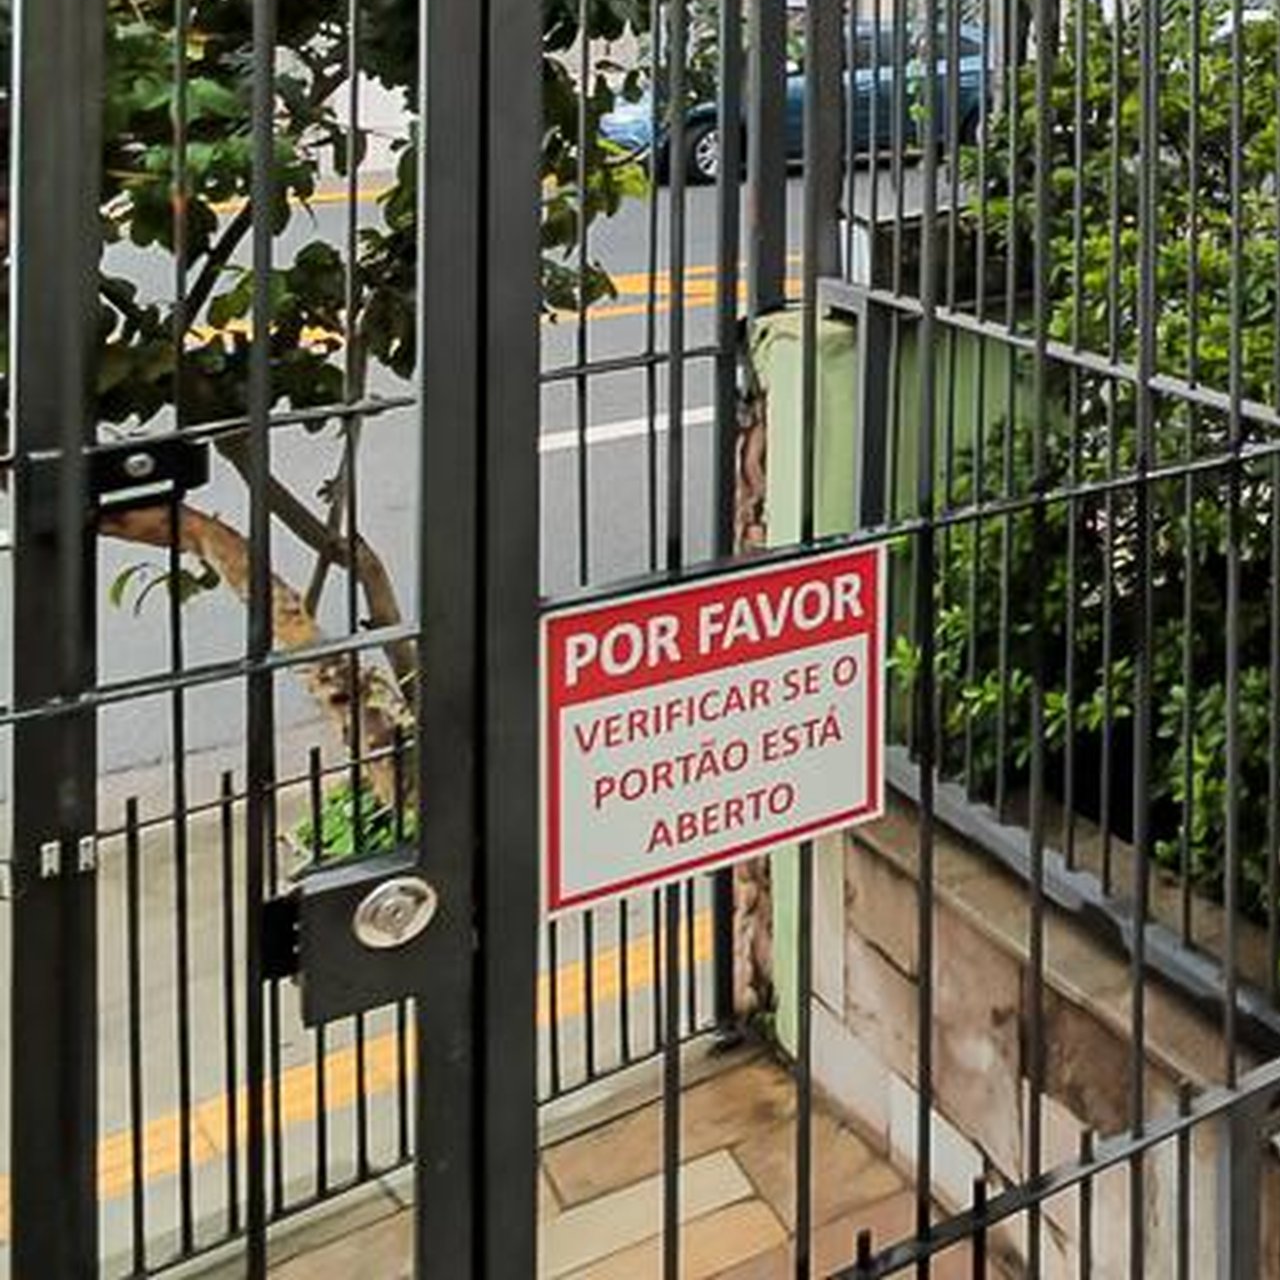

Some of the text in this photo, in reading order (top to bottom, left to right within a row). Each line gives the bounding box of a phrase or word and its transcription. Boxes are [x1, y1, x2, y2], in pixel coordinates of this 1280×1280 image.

[564, 572, 863, 686] POR FAVOR
[574, 656, 858, 754] VERIFICAR SE O
[595, 705, 843, 809] PORTÃO ESTÁ
[646, 784, 794, 852] ABERTO
